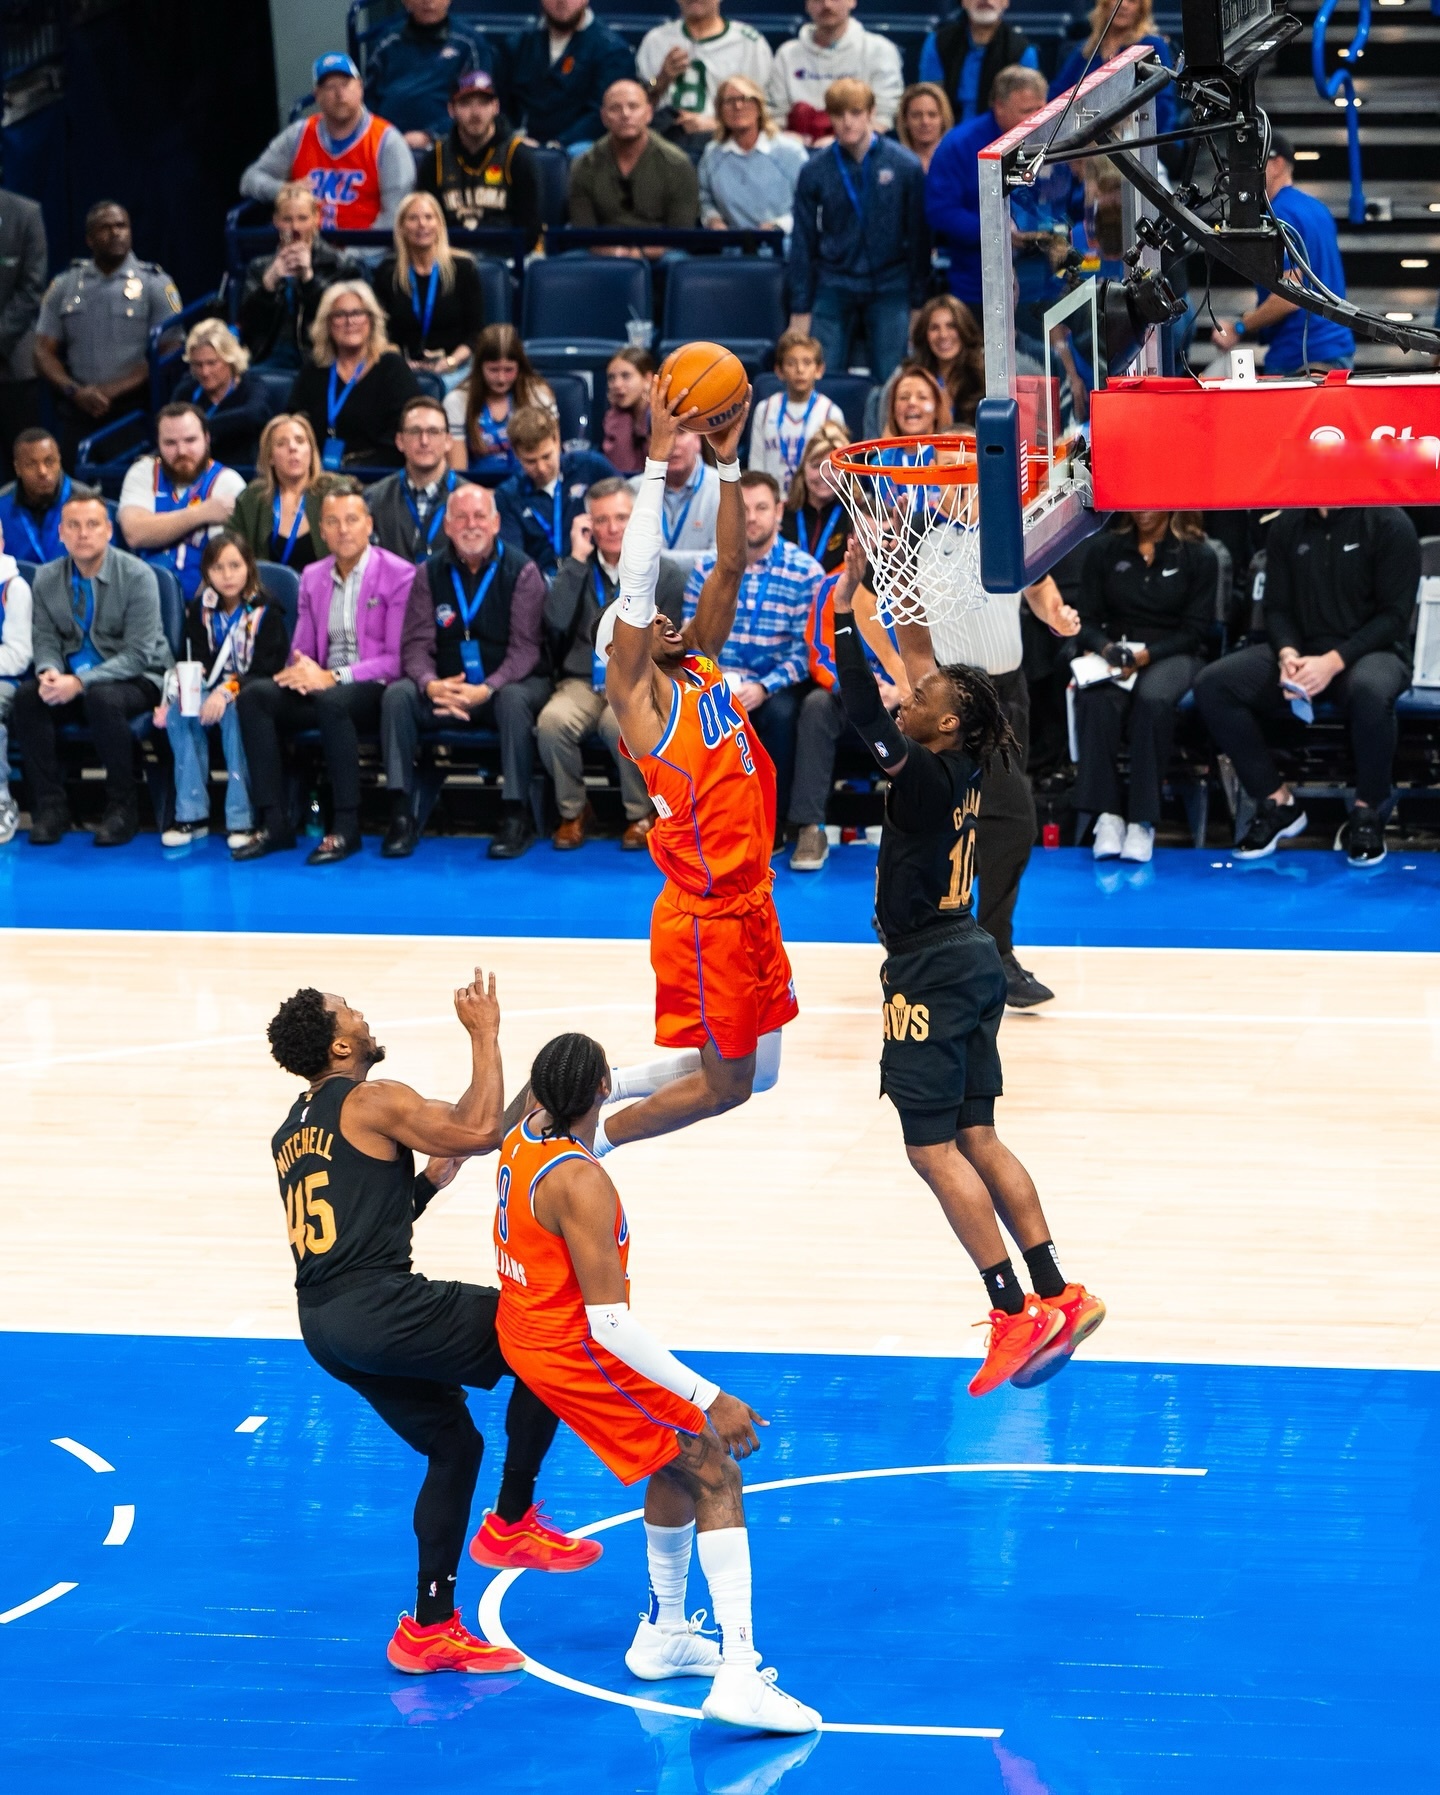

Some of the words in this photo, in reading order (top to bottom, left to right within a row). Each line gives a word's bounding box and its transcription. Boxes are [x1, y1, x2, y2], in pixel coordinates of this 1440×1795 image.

[697, 676, 744, 750] OK
[736, 731, 756, 776] 2
[939, 828, 976, 910] 10
[276, 1126, 334, 1179] MITCHELL
[286, 1170, 337, 1260] 45
[498, 1164, 512, 1244] 8
